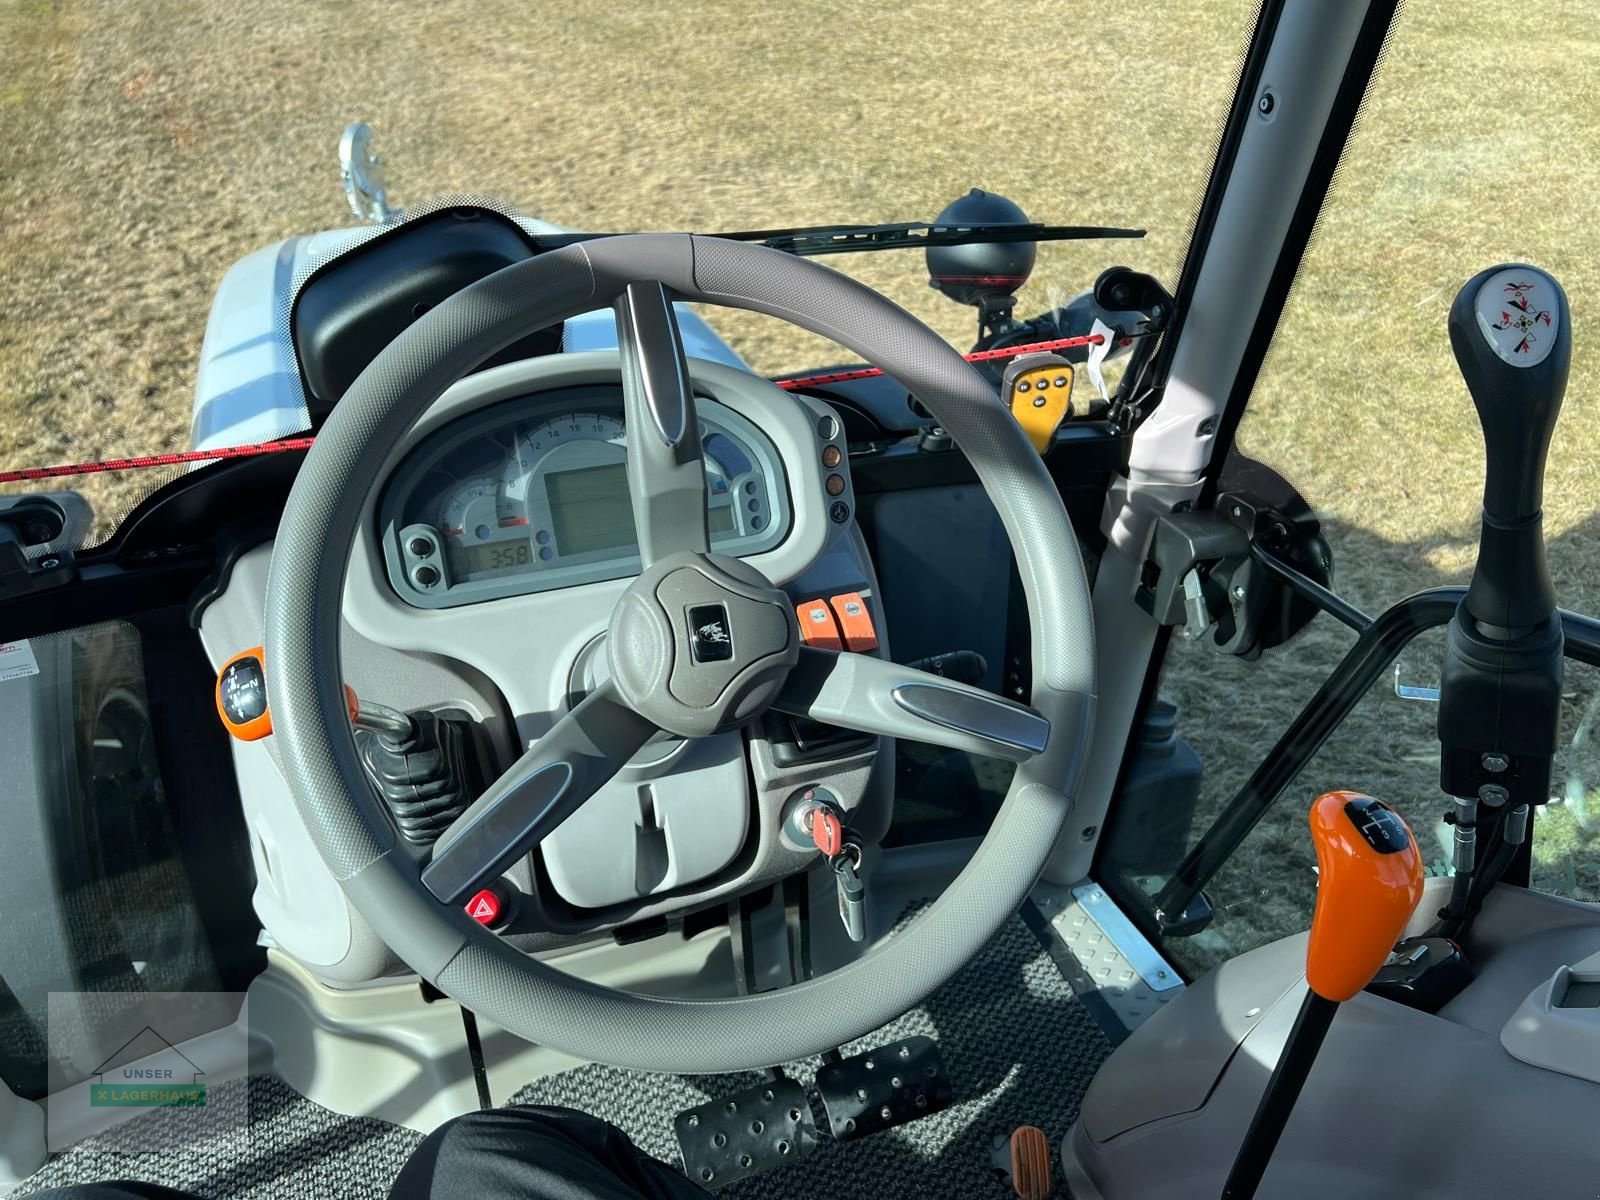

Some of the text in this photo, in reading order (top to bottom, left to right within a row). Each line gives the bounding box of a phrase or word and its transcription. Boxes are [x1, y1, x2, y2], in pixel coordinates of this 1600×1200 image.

[548, 430, 560, 438] 14
[613, 431, 625, 439] 20
[529, 442, 541, 450] 12
[249, 678, 259, 689] N
[1362, 807, 1372, 816] 2
[1381, 830, 1390, 840] 3
[1368, 835, 1375, 845] 1
